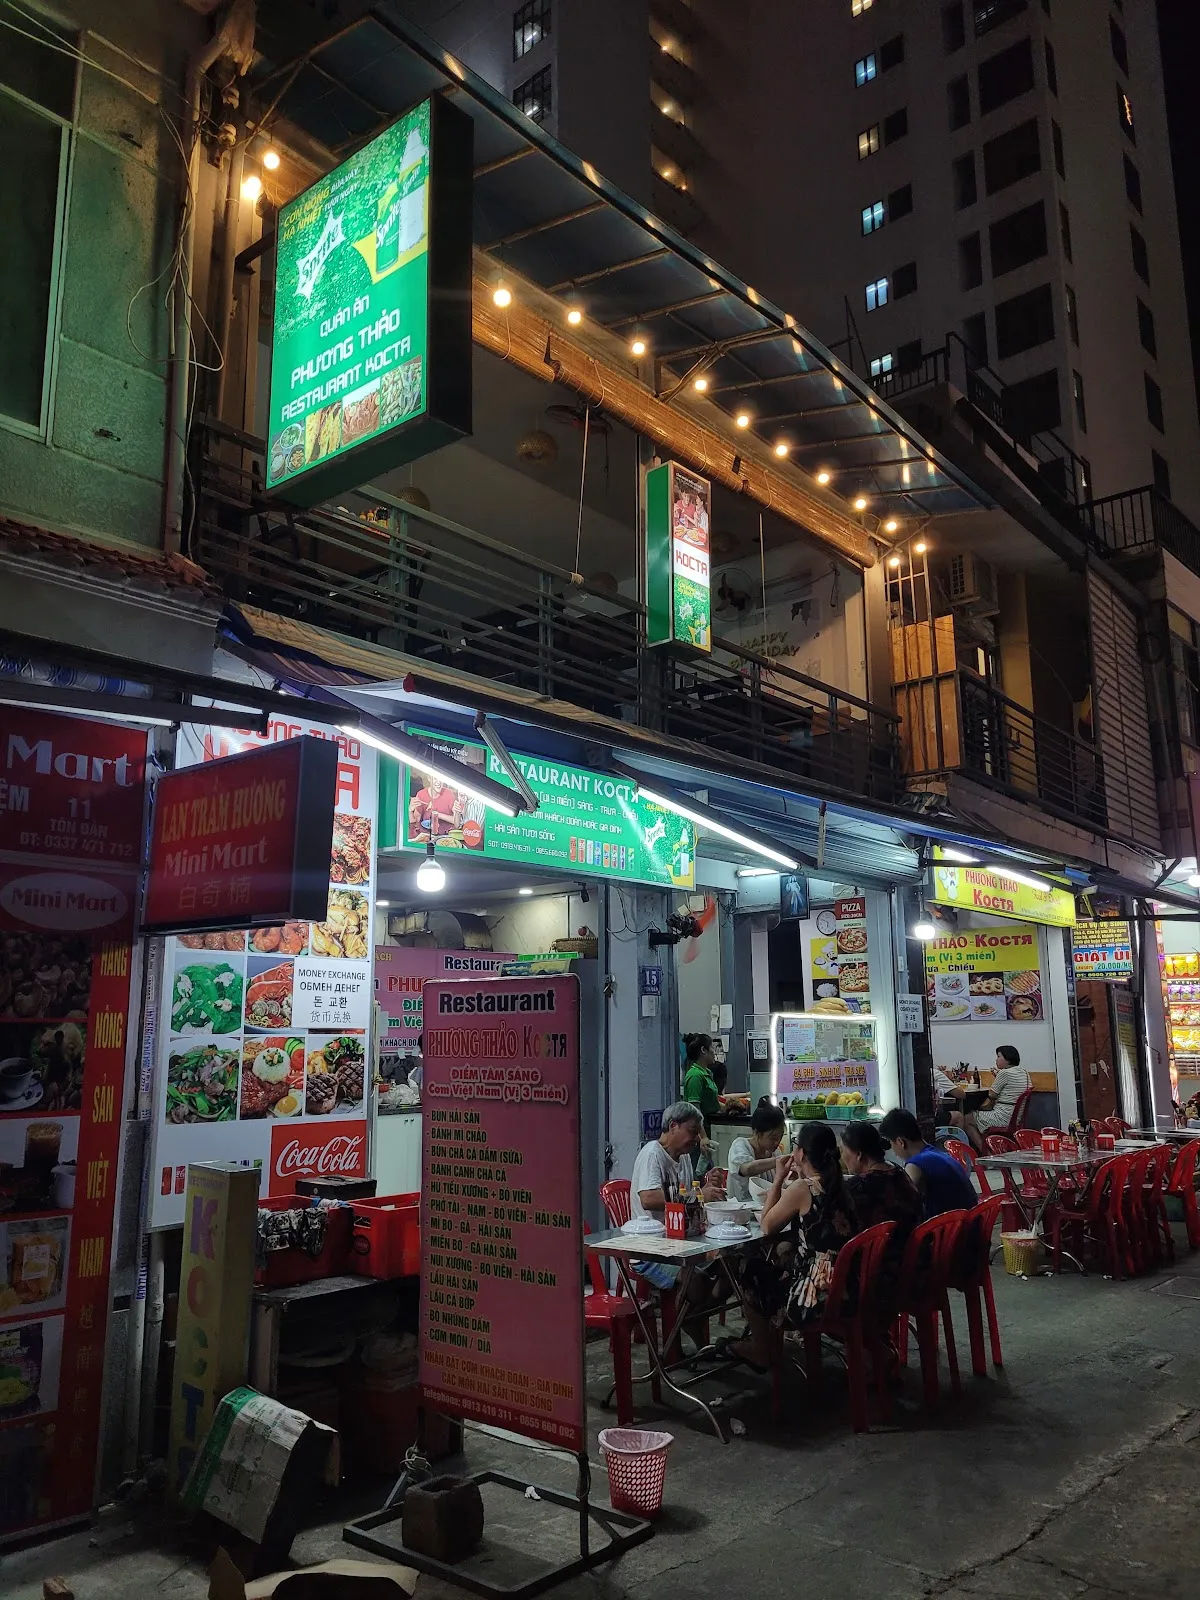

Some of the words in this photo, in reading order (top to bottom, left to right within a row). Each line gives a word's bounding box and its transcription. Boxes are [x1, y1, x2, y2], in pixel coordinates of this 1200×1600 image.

[302, 225, 340, 287] Sprite
[320, 299, 351, 338] QUÁN
[290, 334, 354, 390] PHƯƠNG
[358, 307, 401, 351] THẢO
[281, 365, 362, 424] RESTAURANT
[7, 733, 134, 788] Mart
[160, 801, 190, 845] LAN
[163, 845, 208, 879] Mini
[211, 835, 269, 873] Mart
[12, 887, 61, 908] Mini
[66, 891, 118, 913] Mart
[842, 902, 861, 913] PIZZA
[956, 953, 963, 961] 3
[299, 968, 327, 978] MONEY
[328, 970, 366, 981] EXCHANGE
[300, 981, 332, 992] ОБМЕН
[334, 983, 360, 994] ДЕНЕГ
[646, 970, 657, 986] 15
[313, 995, 323, 1008] 돈
[439, 989, 555, 1013] Restaurant
[427, 1026, 481, 1058] PHƯƠNG
[481, 1019, 518, 1058] THẢO
[476, 1085, 500, 1097] Nam
[522, 1087, 530, 1098] 3
[454, 1165, 475, 1179] CANH
[79, 1236, 104, 1278] NAM
